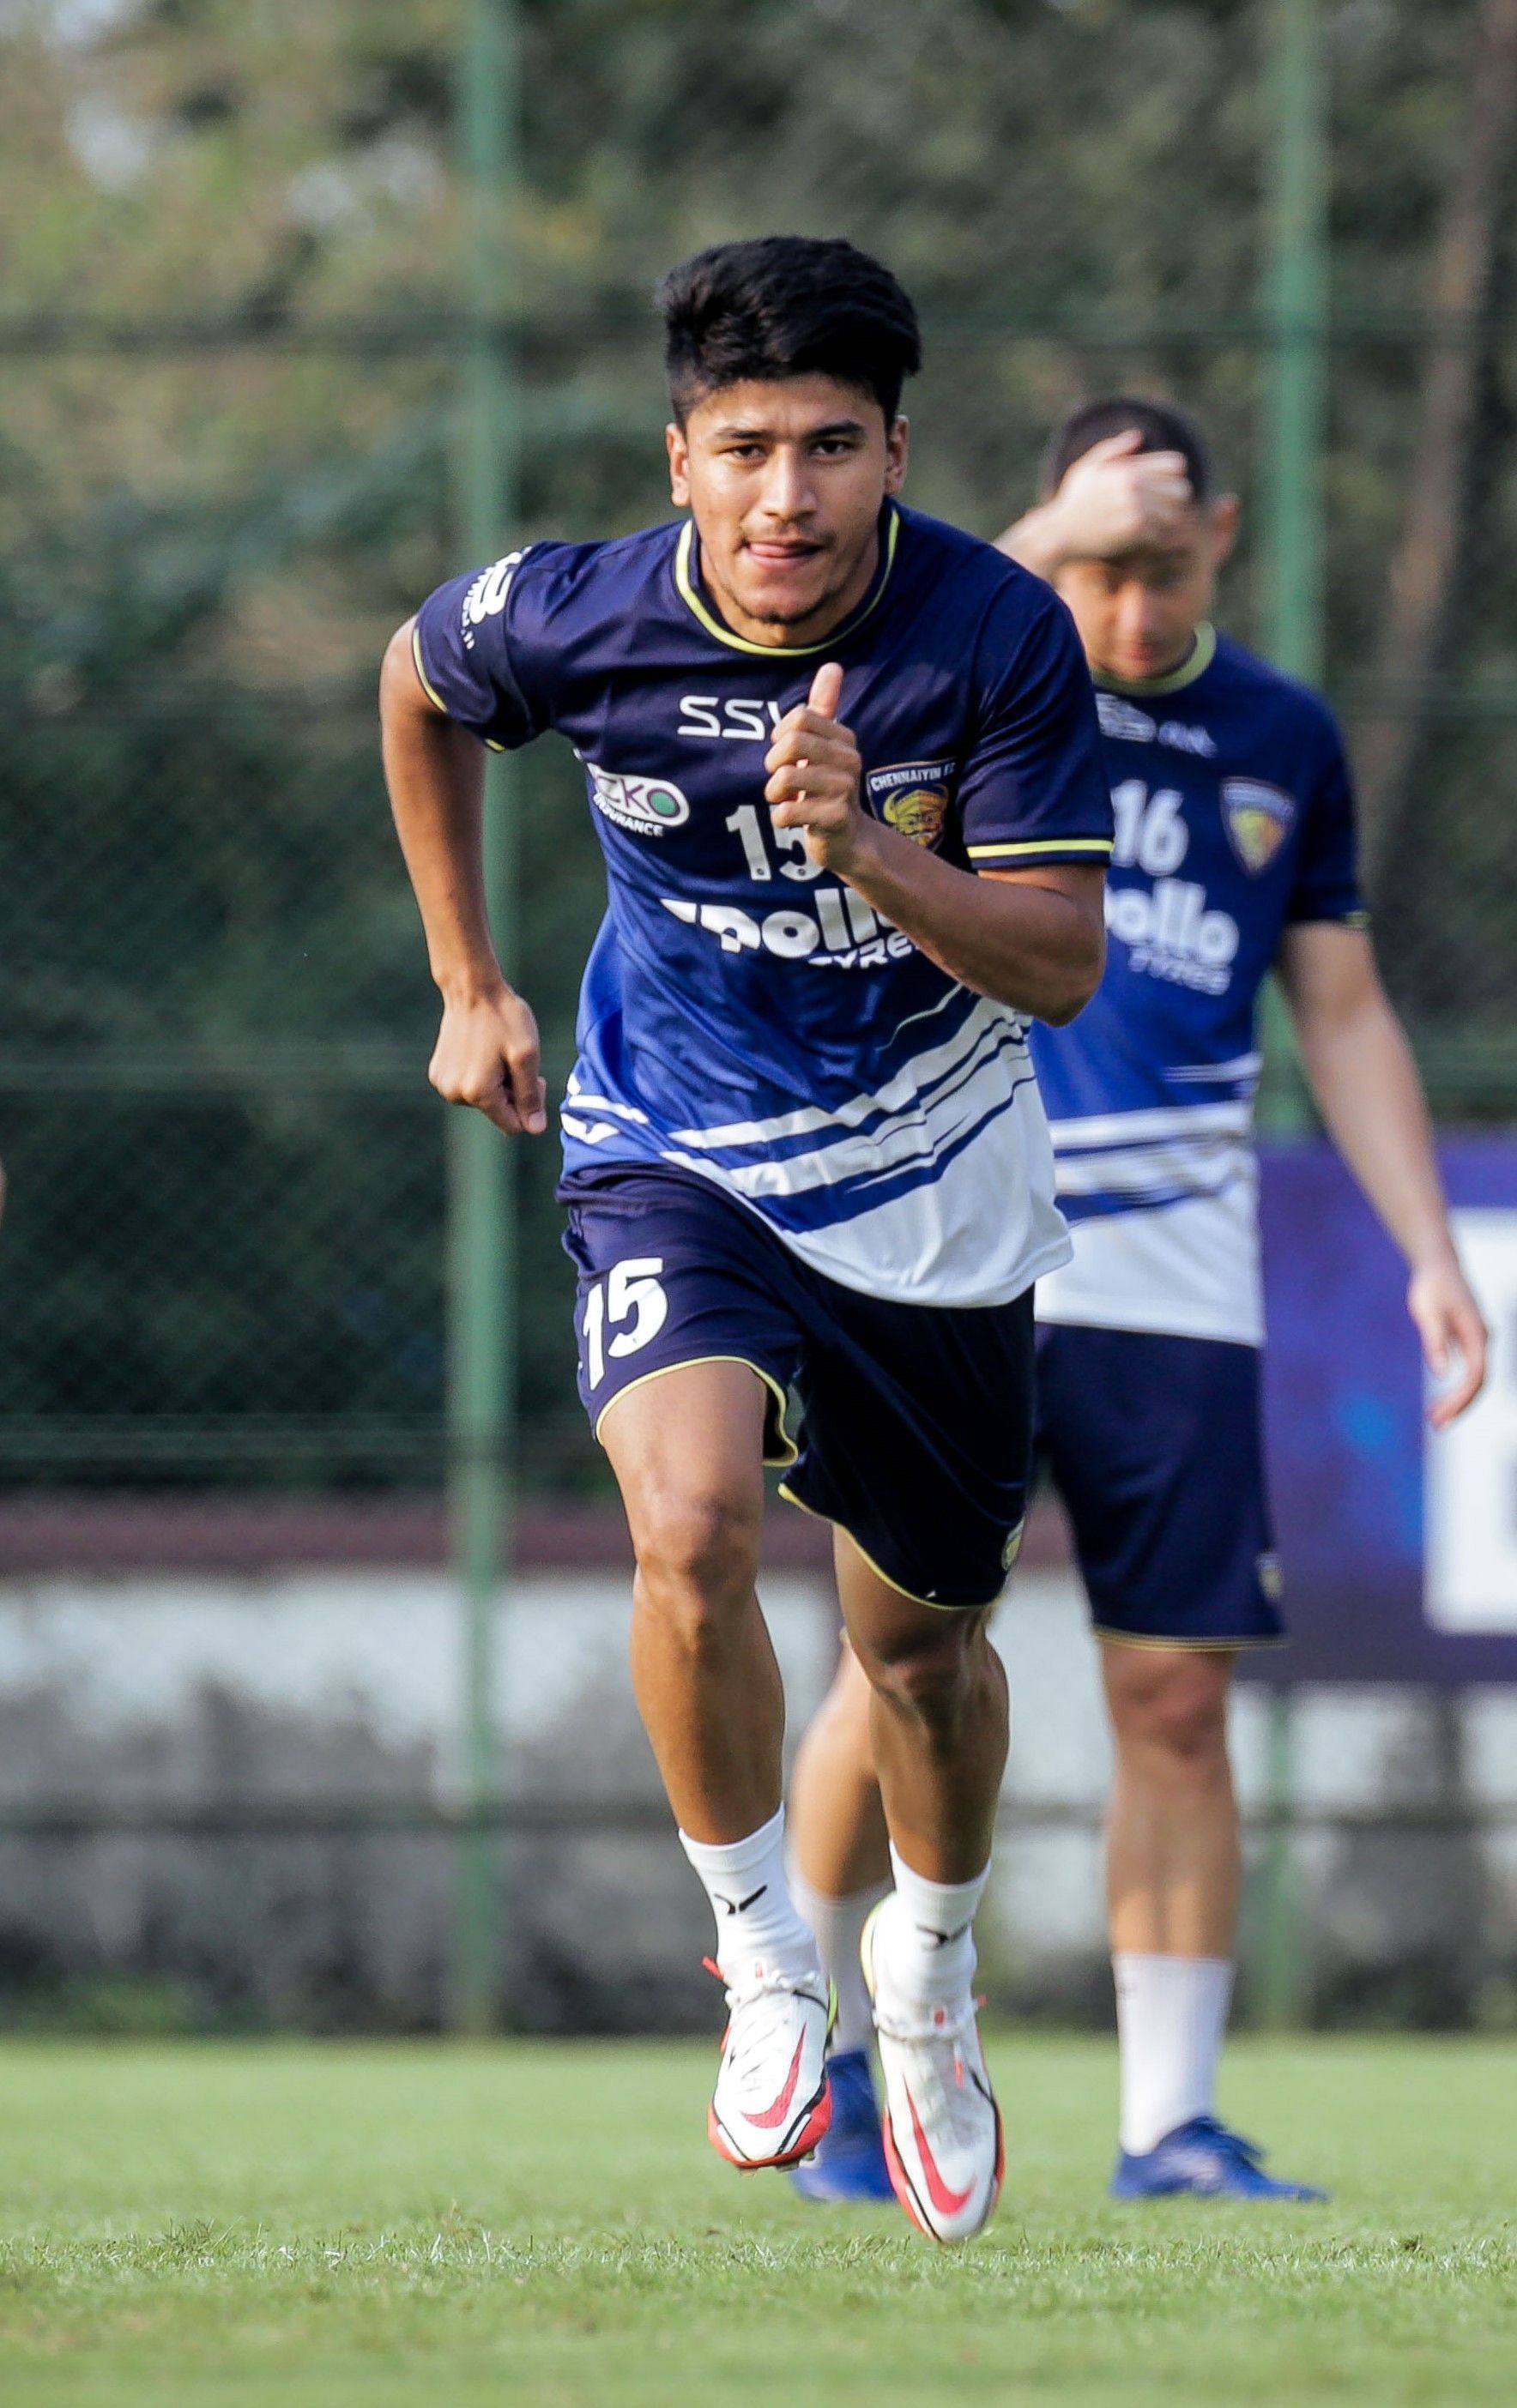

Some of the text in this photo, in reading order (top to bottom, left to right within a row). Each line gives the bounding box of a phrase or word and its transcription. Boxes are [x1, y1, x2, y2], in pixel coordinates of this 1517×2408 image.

[870, 767, 942, 792] CHENNAIYIN
[725, 805, 825, 881] 15
[1110, 779, 1190, 877] 16
[582, 1258, 668, 1391] 15
